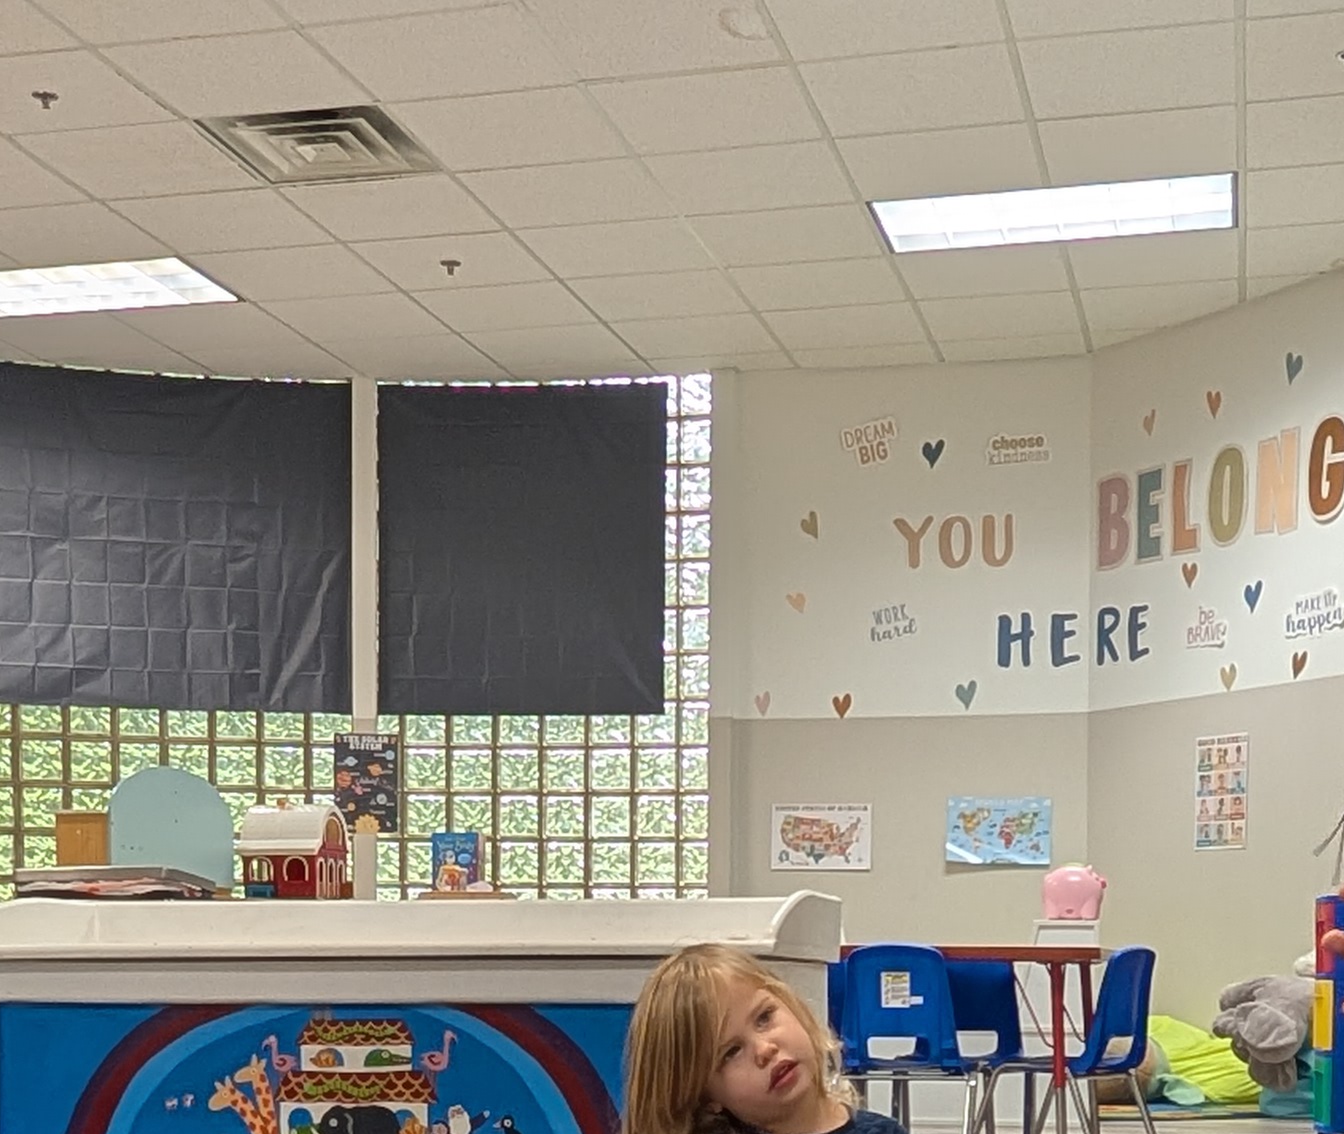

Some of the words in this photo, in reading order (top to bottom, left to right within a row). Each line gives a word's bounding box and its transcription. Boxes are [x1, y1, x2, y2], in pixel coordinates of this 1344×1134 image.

[843, 420, 896, 449] DREAM
[991, 435, 1044, 451] choose
[859, 441, 889, 465] BIG
[987, 449, 1050, 465] kindness
[893, 513, 1015, 569] YOU
[872, 603, 910, 625] WORK
[1199, 605, 1215, 625] be
[1296, 595, 1321, 615] MAKE
[870, 618, 918, 642] hard
[1286, 607, 1343, 636] happen
[996, 604, 1150, 668] HERE
